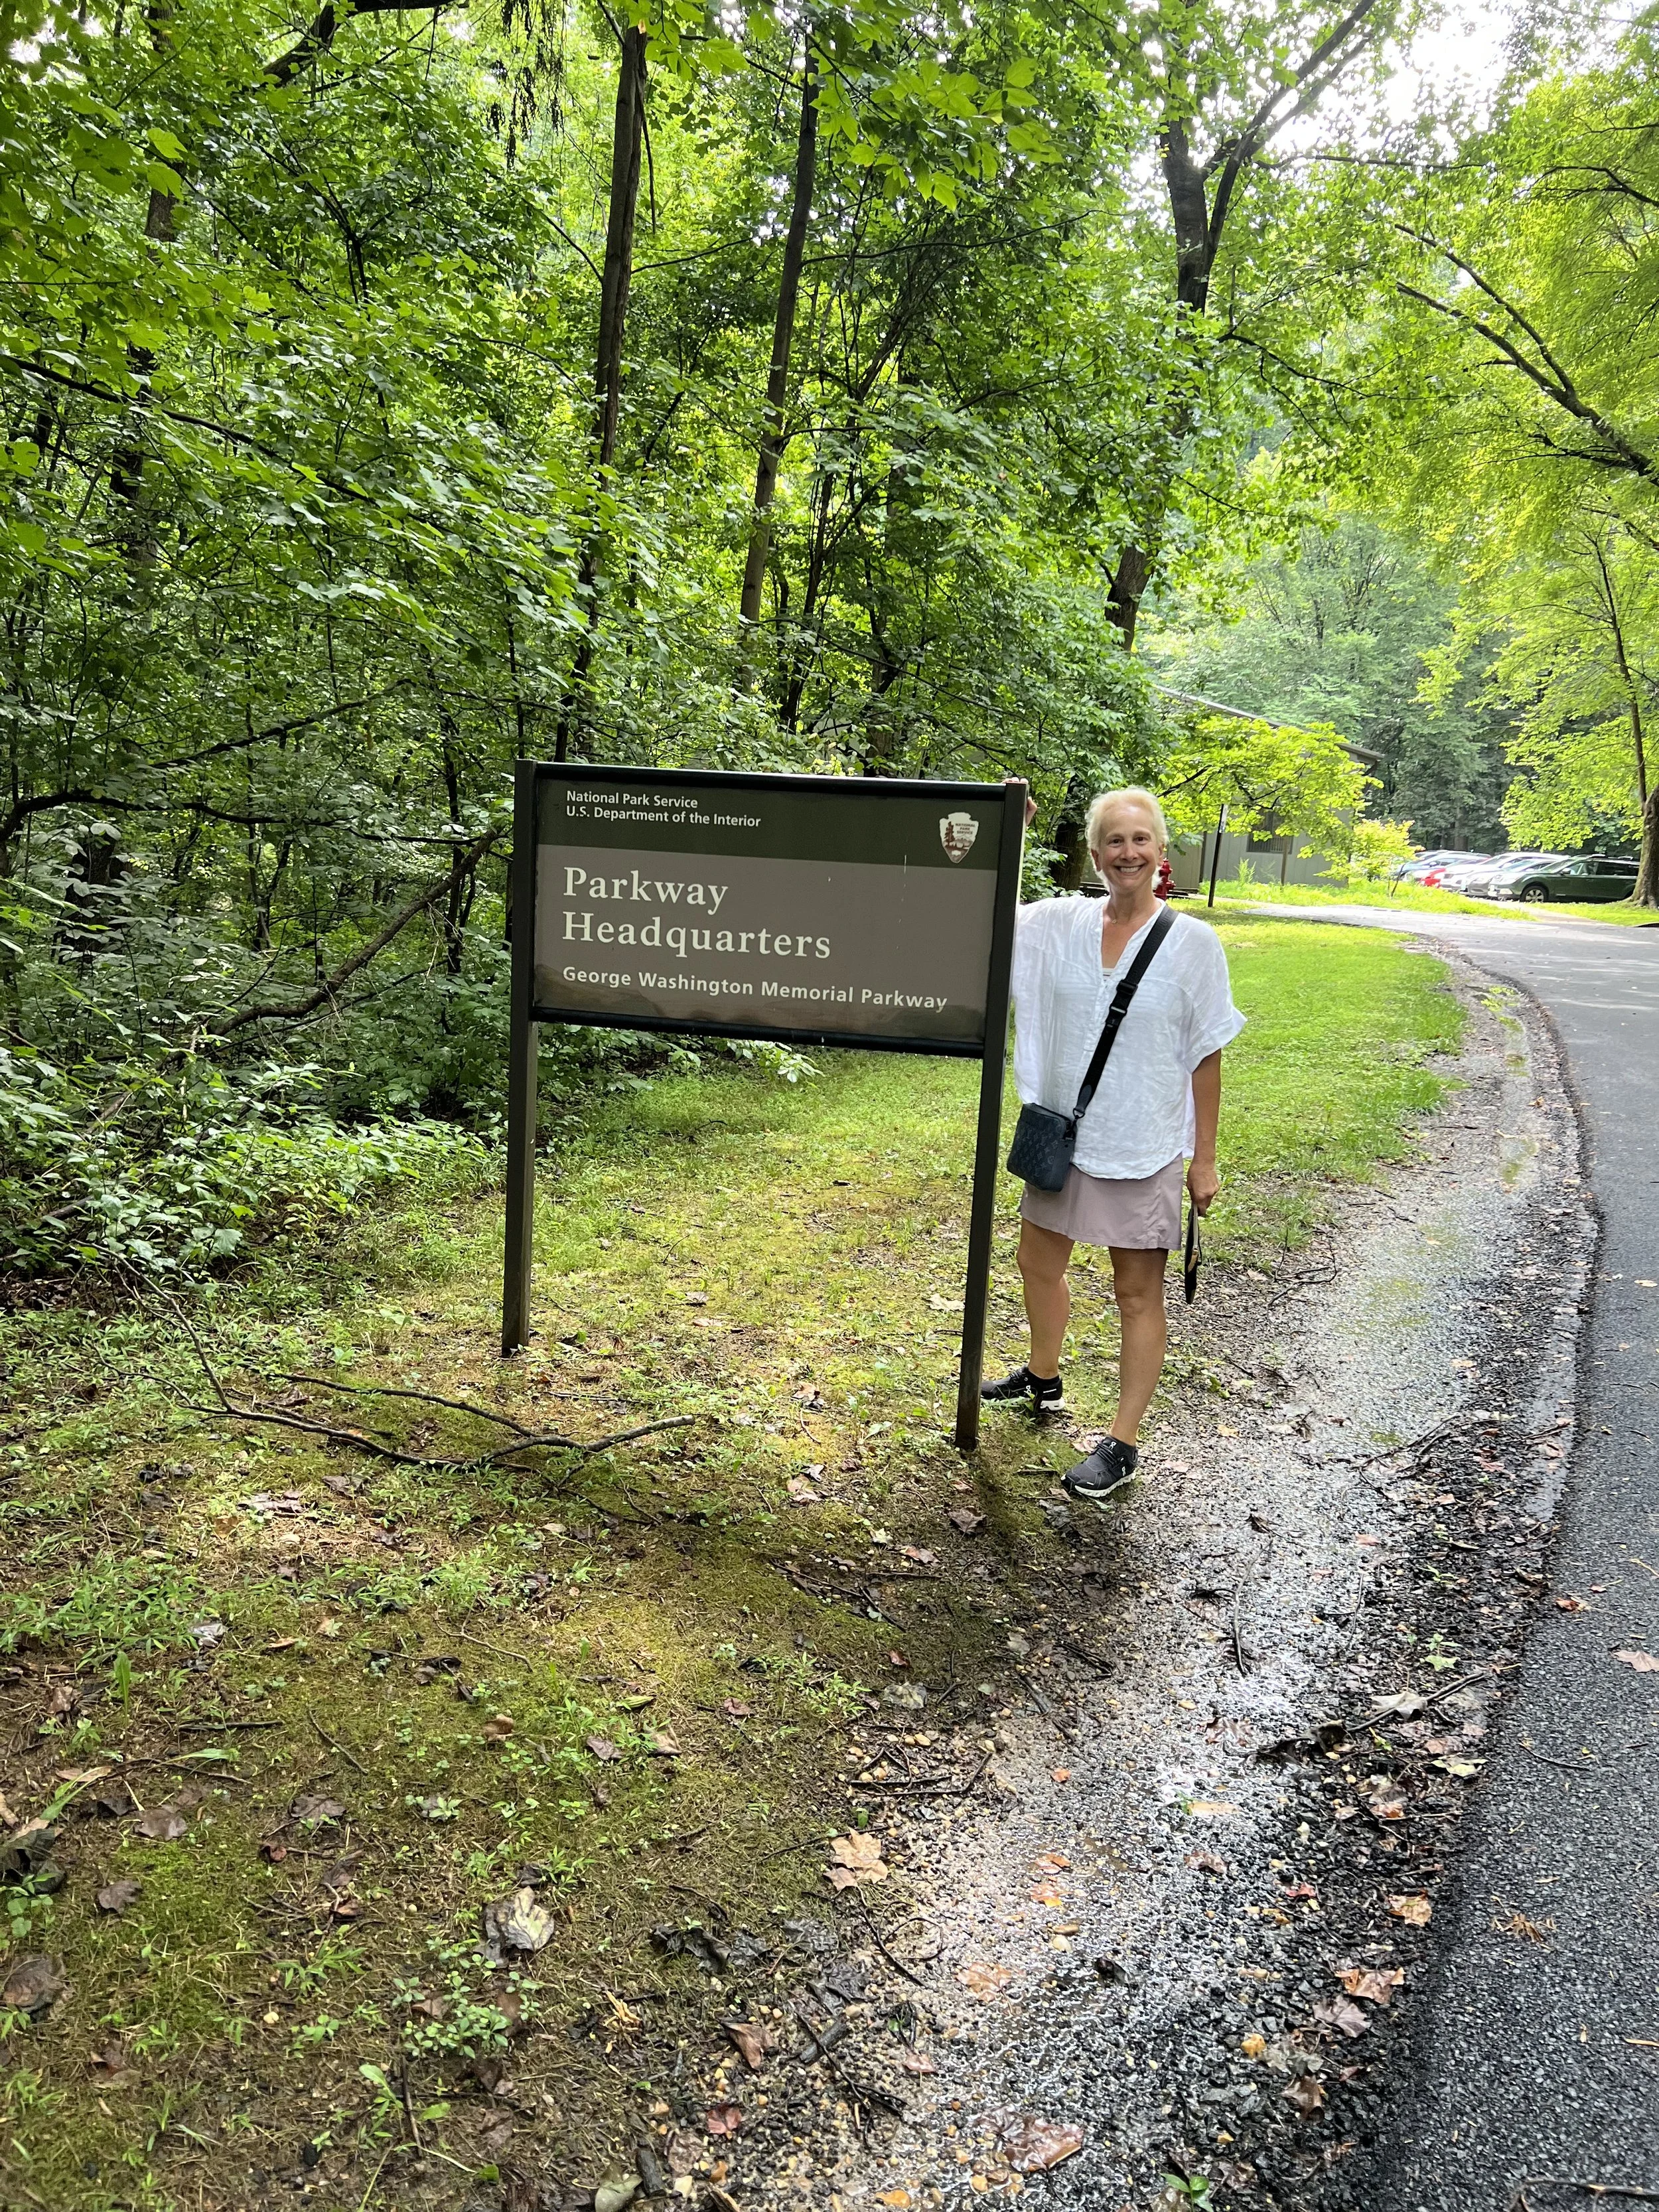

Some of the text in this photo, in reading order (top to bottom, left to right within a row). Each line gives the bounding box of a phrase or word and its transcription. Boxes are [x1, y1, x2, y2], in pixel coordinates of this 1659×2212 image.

[566, 805, 762, 827] U.S. Department of the Interior
[567, 790, 698, 808] National Park Service
[563, 866, 729, 915] Parkway
[562, 911, 831, 959] Headquarters
[563, 966, 948, 1013] George Washington Memorial Parkway
